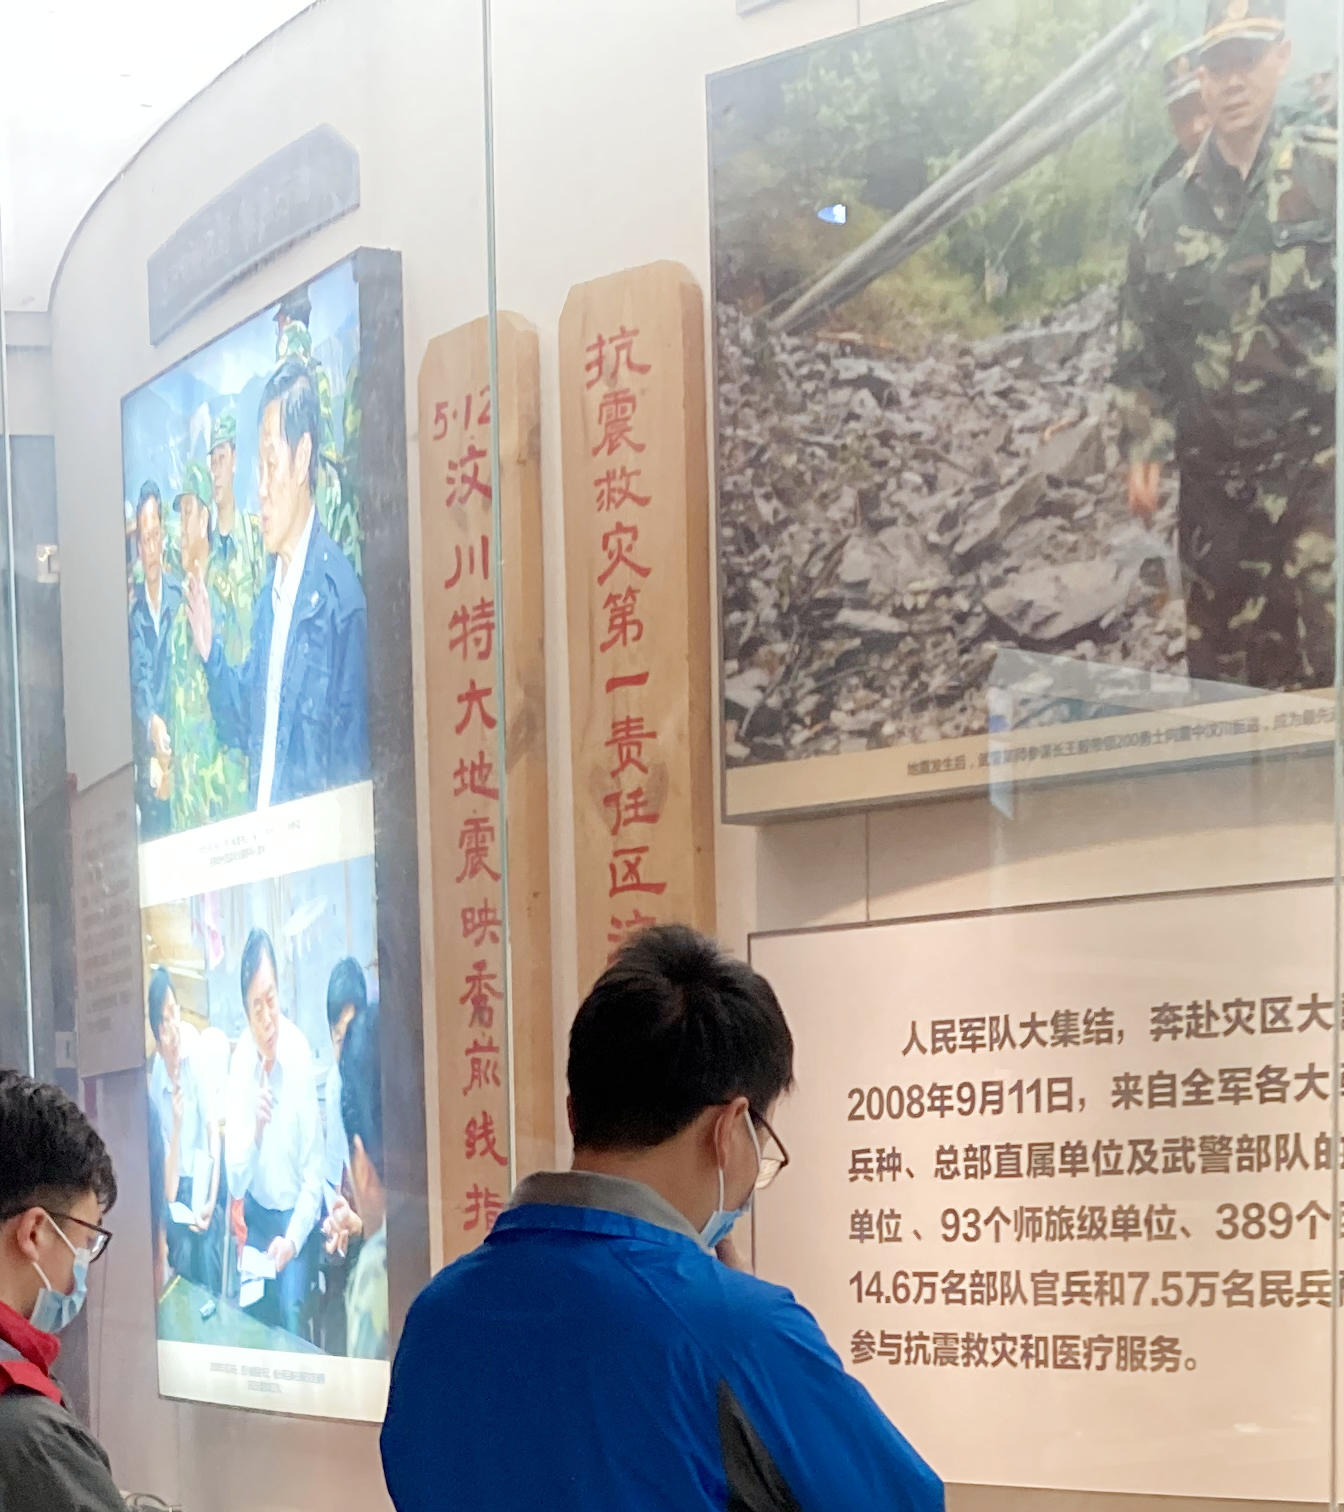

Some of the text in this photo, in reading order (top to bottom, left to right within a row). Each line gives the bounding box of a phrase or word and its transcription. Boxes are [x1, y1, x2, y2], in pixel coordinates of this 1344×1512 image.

[849, 1328, 1201, 1374] 参与抗震救灾和医疗服务。
